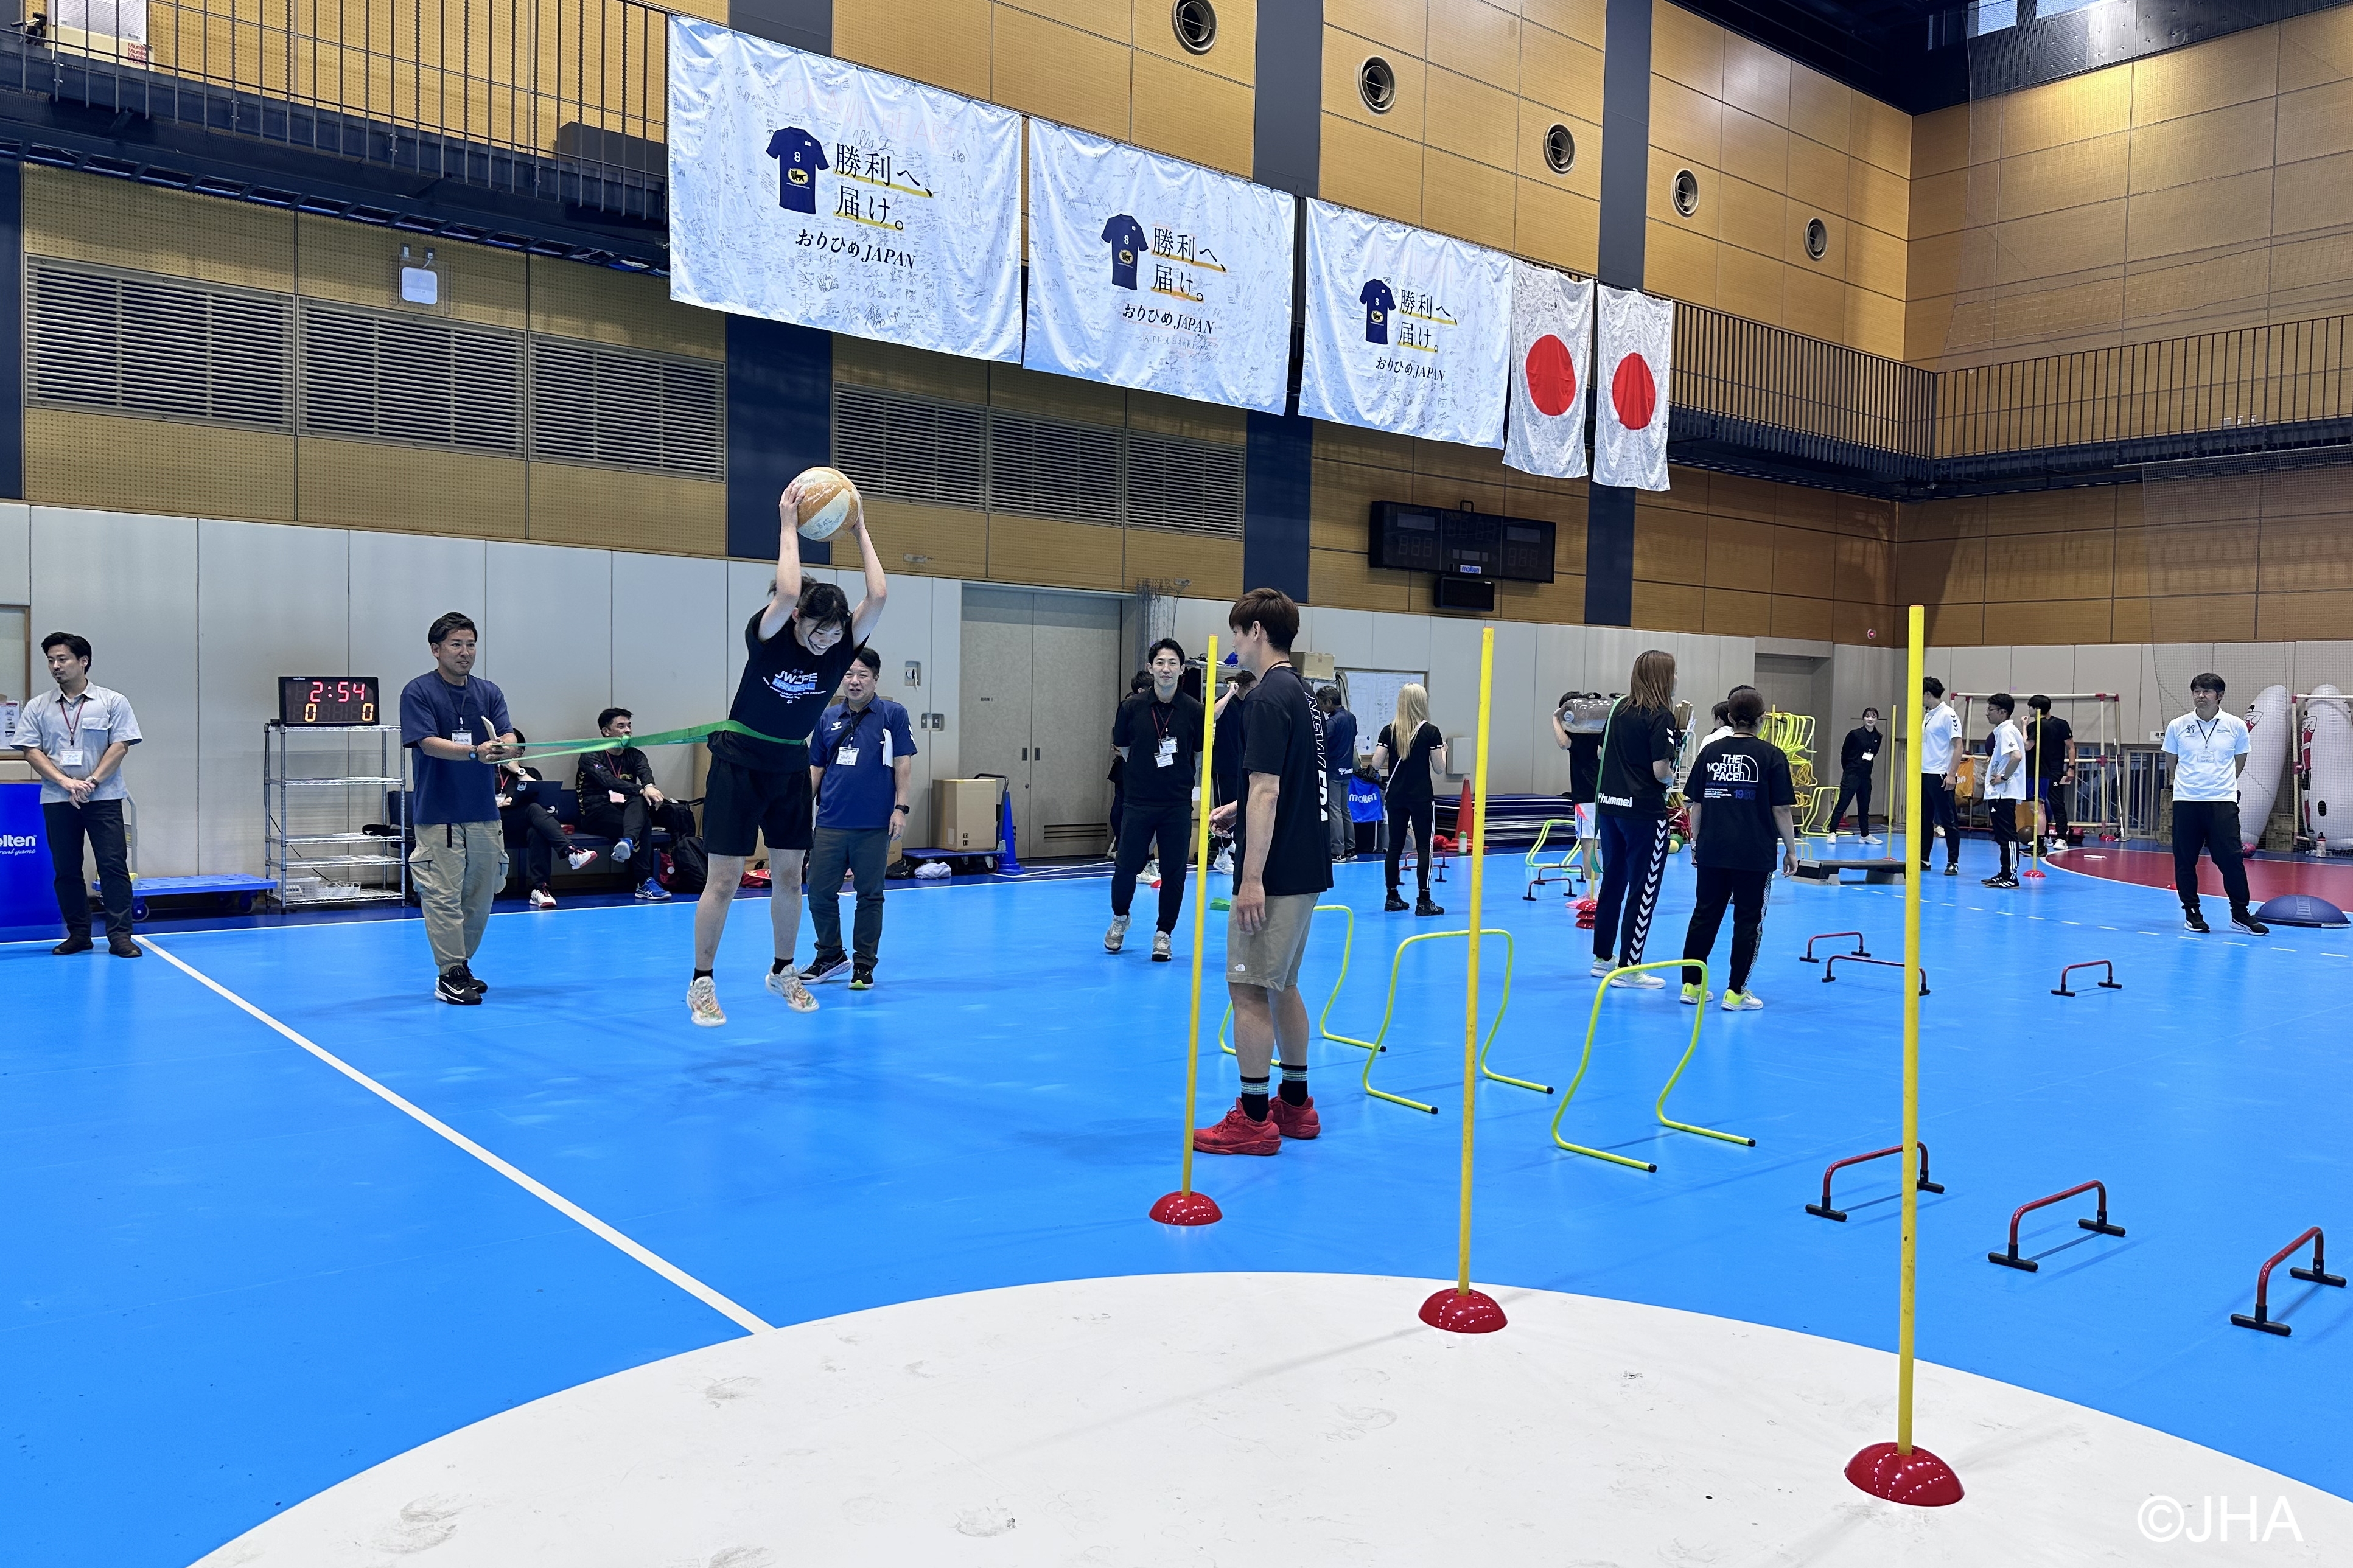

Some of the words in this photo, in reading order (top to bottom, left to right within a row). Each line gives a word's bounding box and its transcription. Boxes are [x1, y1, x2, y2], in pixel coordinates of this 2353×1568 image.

[794, 152, 801, 162] 8
[835, 143, 932, 197] 勝利へ、
[836, 185, 904, 231] 届け。
[795, 229, 916, 269] おりひめJAPAN
[1124, 235, 1129, 245] 8
[1152, 228, 1226, 271] 勝利へ、
[1152, 263, 1204, 302] 届け。
[1375, 297, 1379, 306] 8
[1400, 289, 1458, 326] 勝利へ、
[1122, 304, 1215, 334] おりひめJAPAN
[1398, 321, 1438, 353] 届け。
[310, 681, 365, 702] 2:54
[304, 703, 317, 722] 0
[362, 703, 374, 722] 0
[1707, 762, 1741, 773] NORTH
[1721, 754, 1741, 764] THE
[1713, 772, 1740, 782] FACE
[1349, 793, 1377, 803] molten
[1600, 793, 1632, 807] hummel
[0, 834, 36, 847] lten
